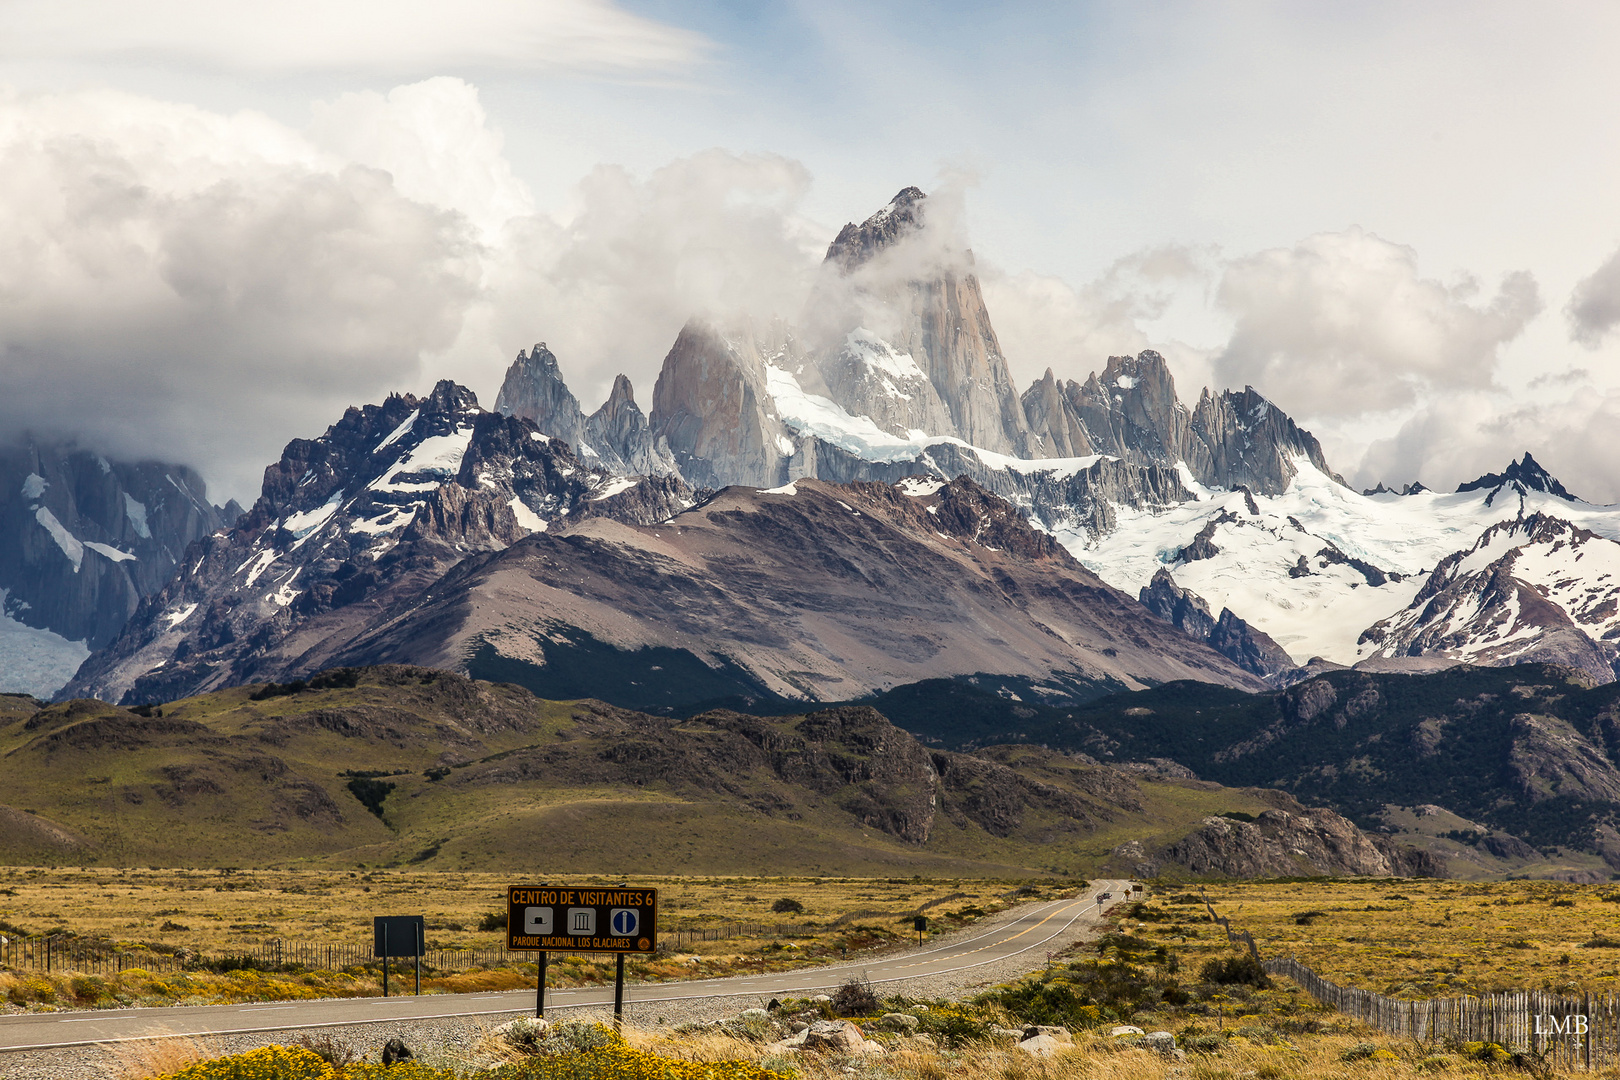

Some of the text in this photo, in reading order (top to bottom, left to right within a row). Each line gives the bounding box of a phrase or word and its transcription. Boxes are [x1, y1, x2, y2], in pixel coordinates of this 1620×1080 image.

[512, 890, 653, 906] CENTRO DE VISITANTES 6
[513, 936, 630, 948] PARQUE NACIONAL LOS GLACIARES
